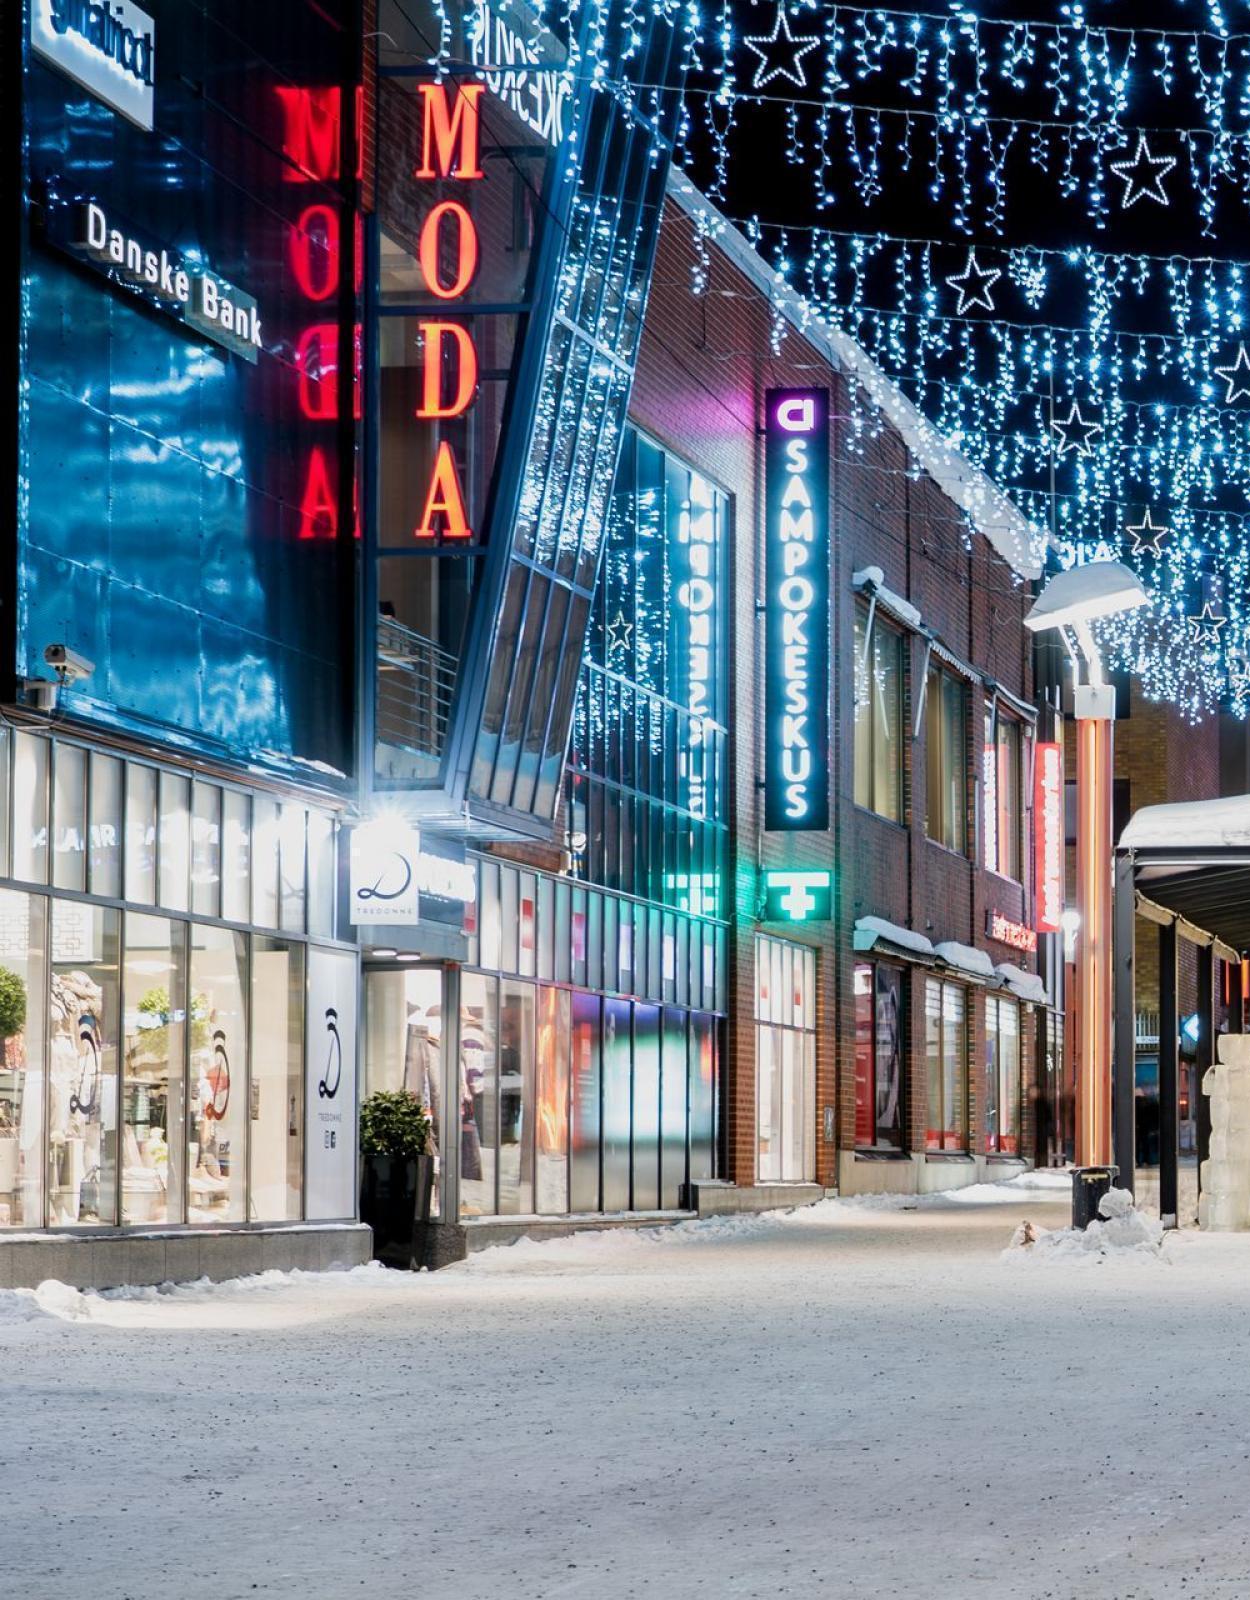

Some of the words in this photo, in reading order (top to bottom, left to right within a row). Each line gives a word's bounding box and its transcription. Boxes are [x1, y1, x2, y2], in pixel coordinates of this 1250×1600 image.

[88, 203, 190, 303] Danske
[202, 278, 263, 349] Bank
[415, 83, 487, 538] MODA
[779, 438, 814, 819] SAMPOKESKUS
[357, 907, 414, 916] TREDONNE
